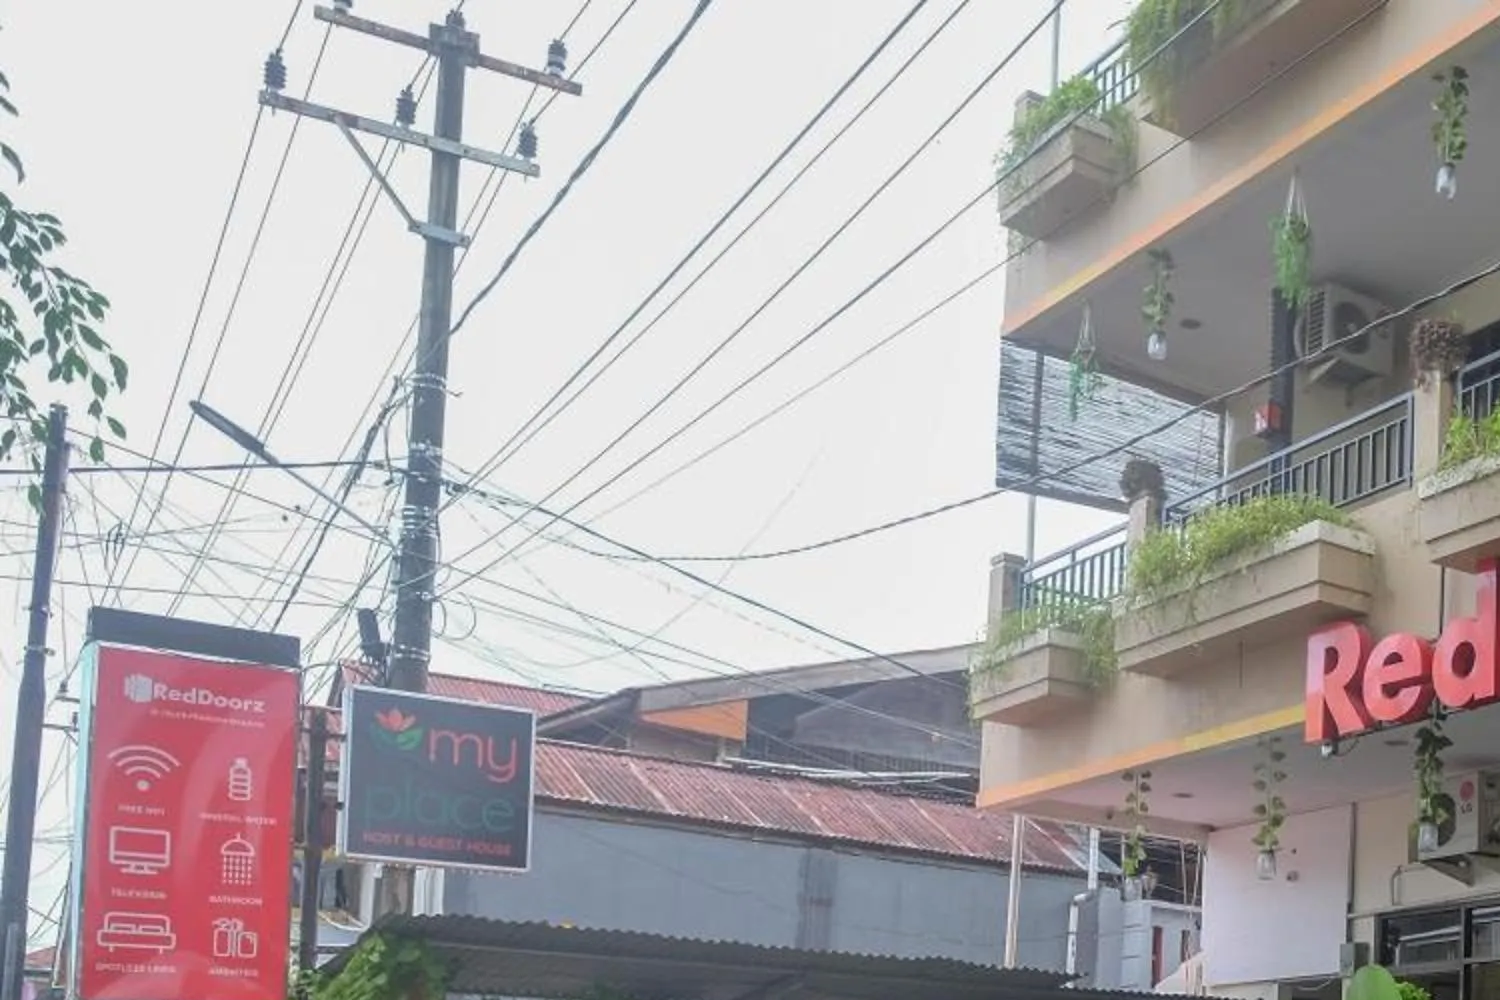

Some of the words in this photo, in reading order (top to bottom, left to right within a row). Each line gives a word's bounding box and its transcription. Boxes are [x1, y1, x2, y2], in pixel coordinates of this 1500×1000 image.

[153, 682, 266, 712] RedDoorz
[429, 729, 518, 784] my
[365, 778, 516, 834] place
[1461, 800, 1473, 814] LG
[417, 835, 463, 851] GUEST
[466, 839, 513, 857] HOUSE
[208, 895, 264, 907] BATHROOM
